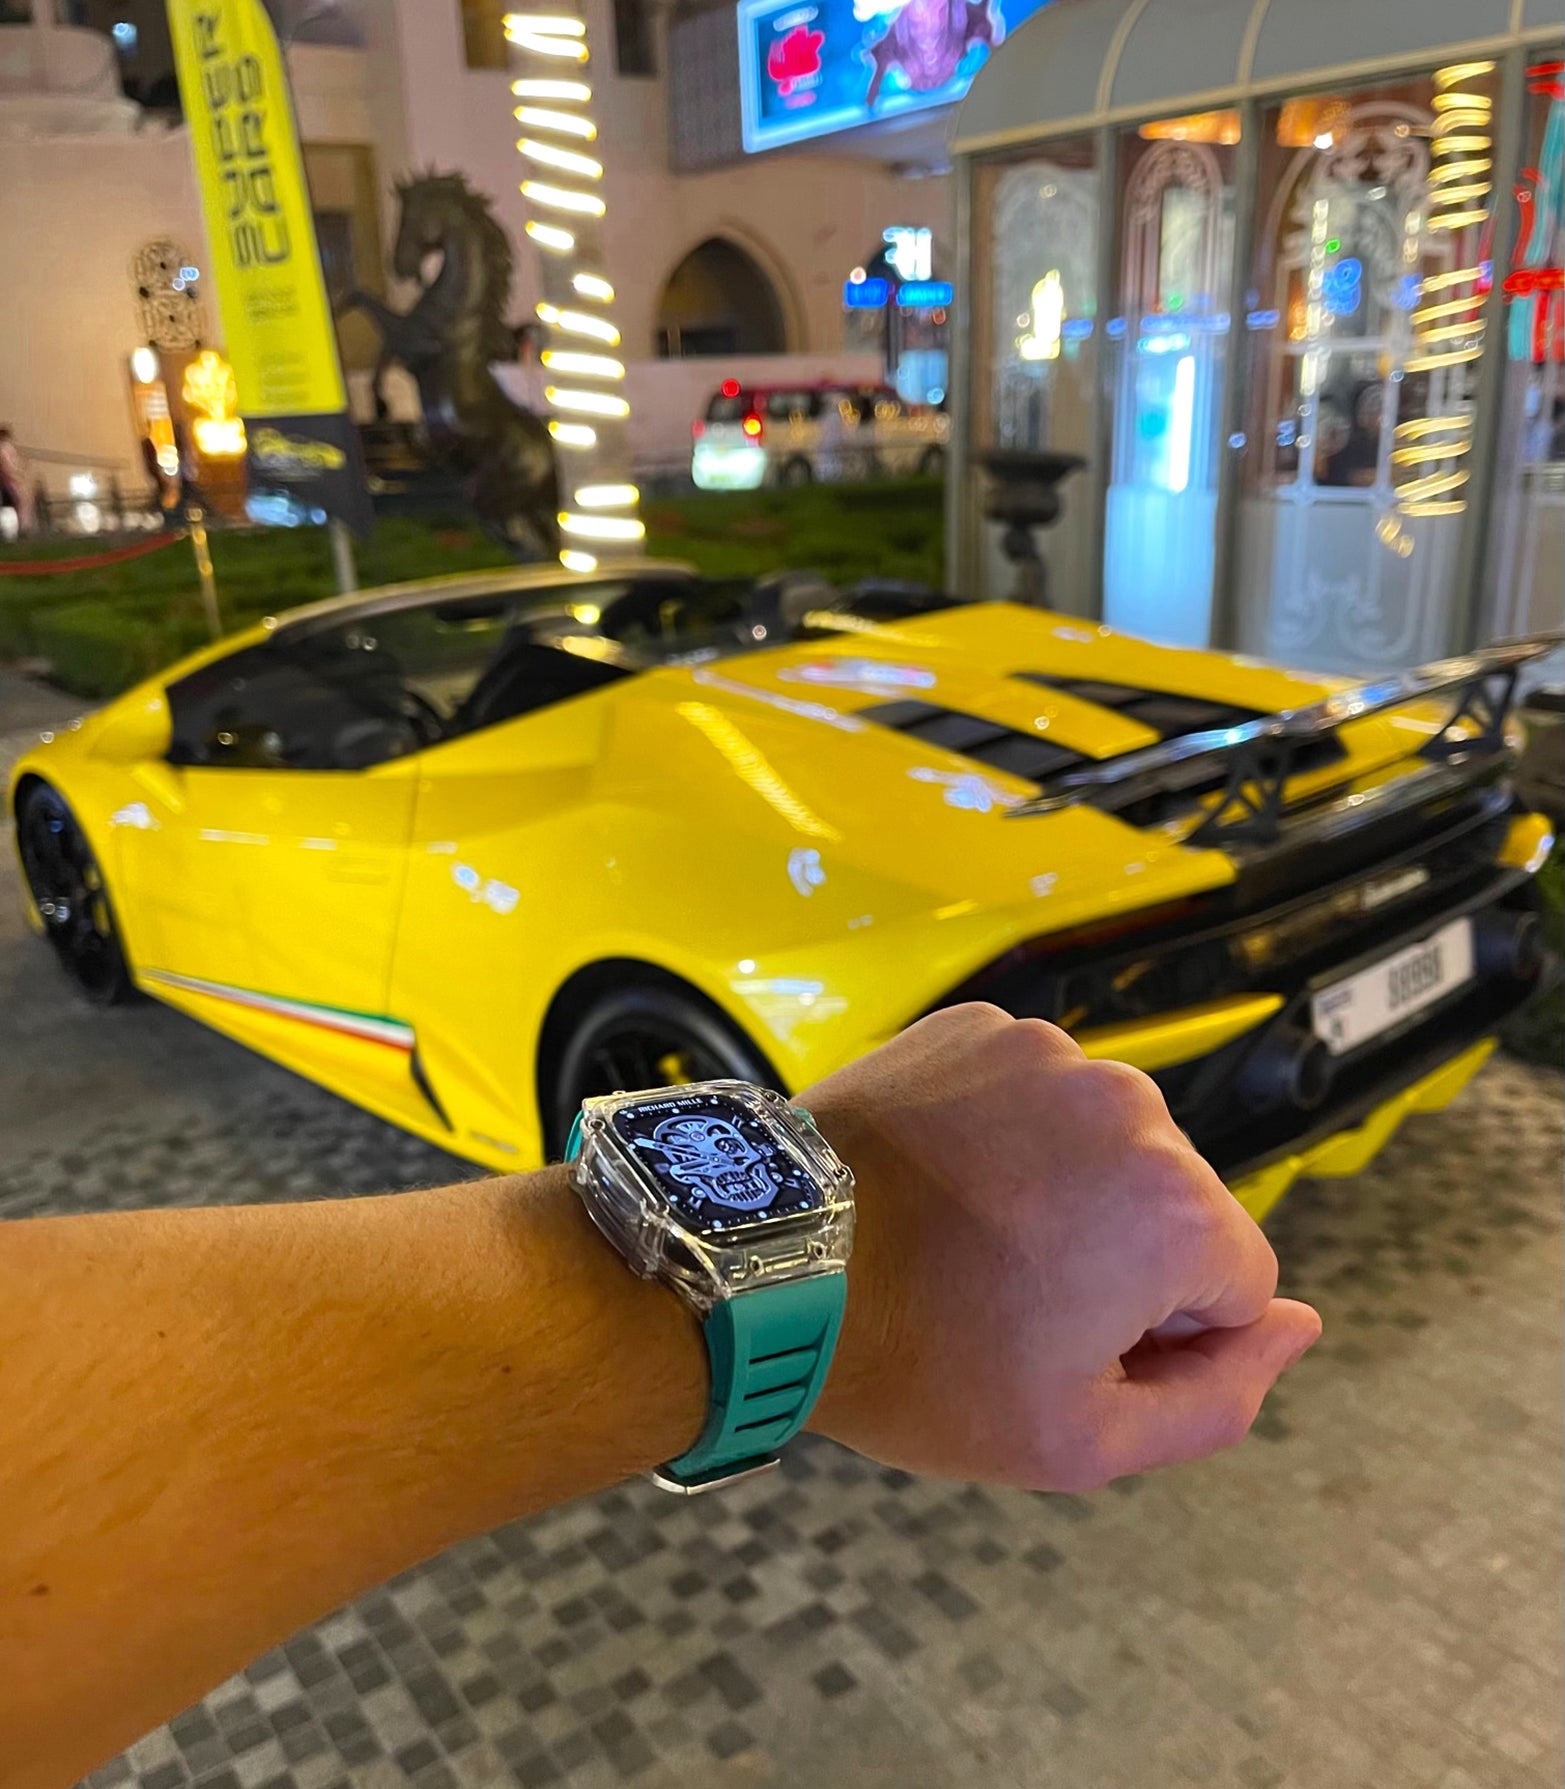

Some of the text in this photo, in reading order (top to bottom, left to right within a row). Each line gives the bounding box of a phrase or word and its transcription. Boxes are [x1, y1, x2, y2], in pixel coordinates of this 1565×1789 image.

[237, 55, 291, 264] CARS
[638, 1098, 703, 1113] RICHARD MILLE
